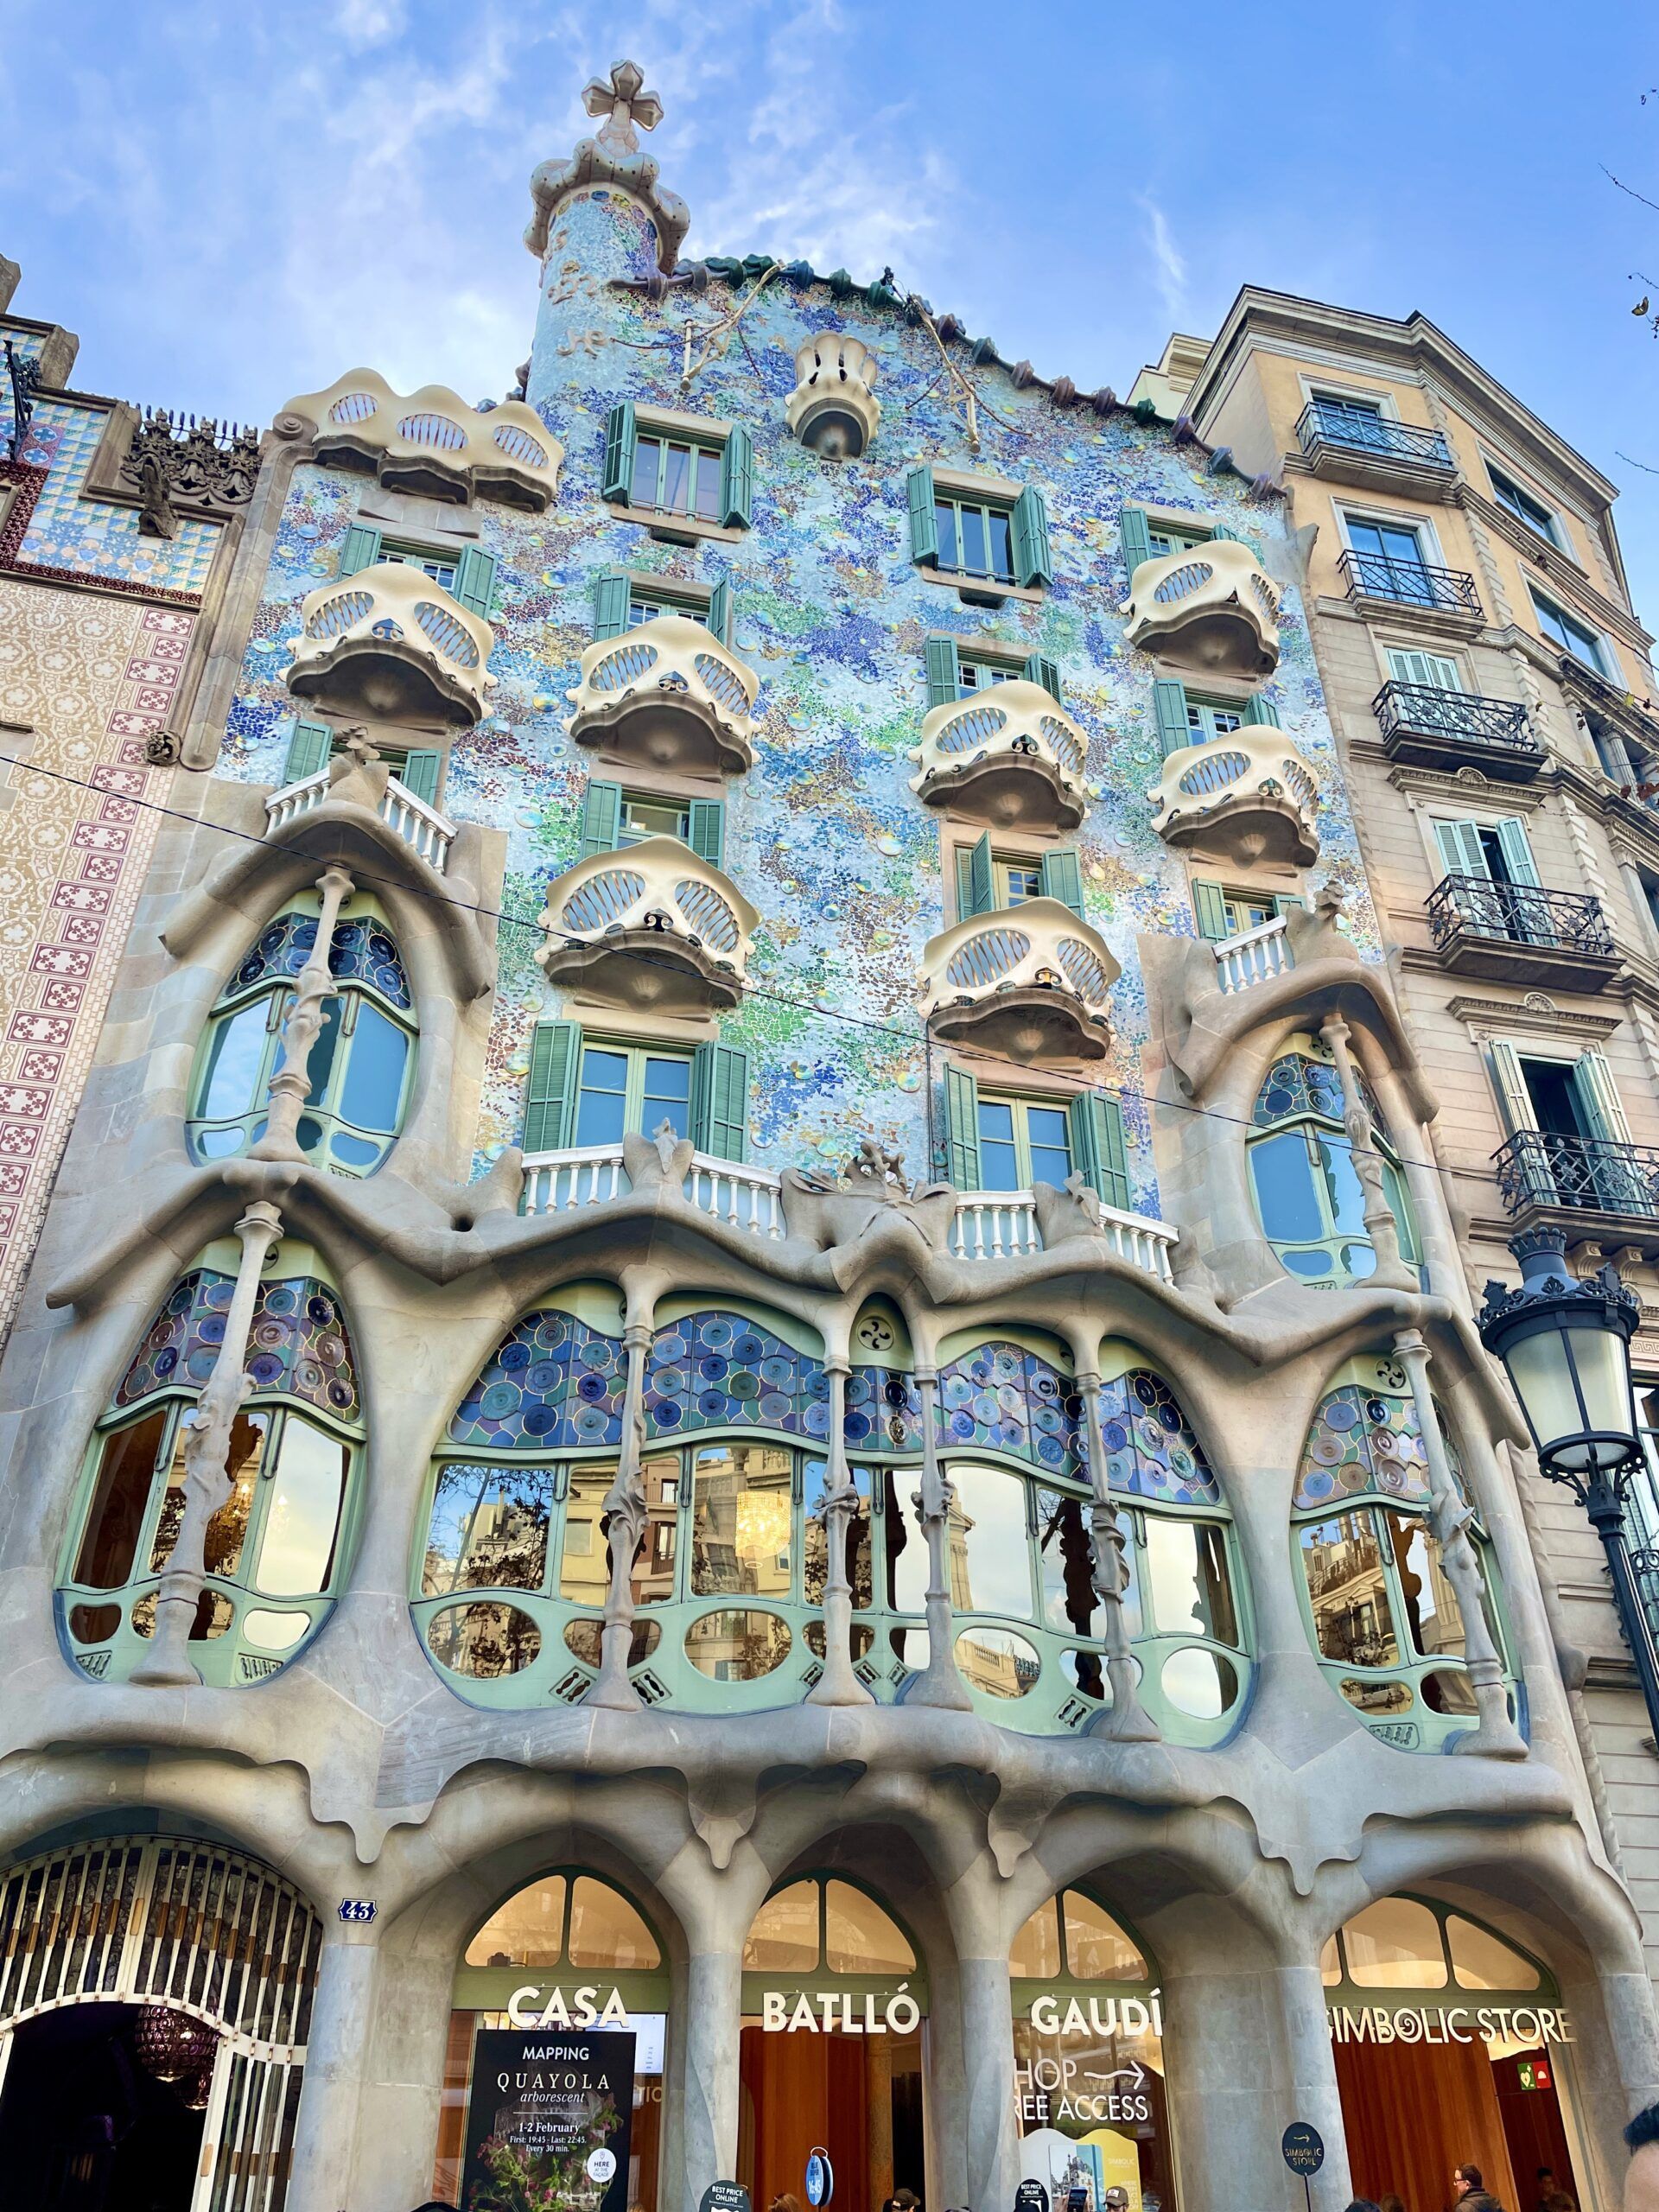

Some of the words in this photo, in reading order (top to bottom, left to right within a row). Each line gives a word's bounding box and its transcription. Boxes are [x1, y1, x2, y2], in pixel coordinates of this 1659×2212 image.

[346, 1902, 371, 1920] 43
[508, 1986, 630, 2029] CASA
[762, 1982, 920, 2035] BATLLÓ
[1031, 1988, 1164, 2037] GAUDÍ
[1477, 2007, 1577, 2044] STORE
[522, 2046, 589, 2061] MAPPING
[497, 2072, 610, 2092] QUAYOLA
[1014, 2058, 1077, 2091] HOP
[520, 2090, 585, 2103] arborescent
[1014, 2094, 1049, 2120] REE
[1057, 2094, 1148, 2121] ACCESS
[519, 2123, 533, 2133] 1-2
[536, 2122, 580, 2135] February
[711, 2185, 726, 2194] BEST
[726, 2188, 744, 2197] PRICE
[715, 2193, 738, 2203] ONLINE
